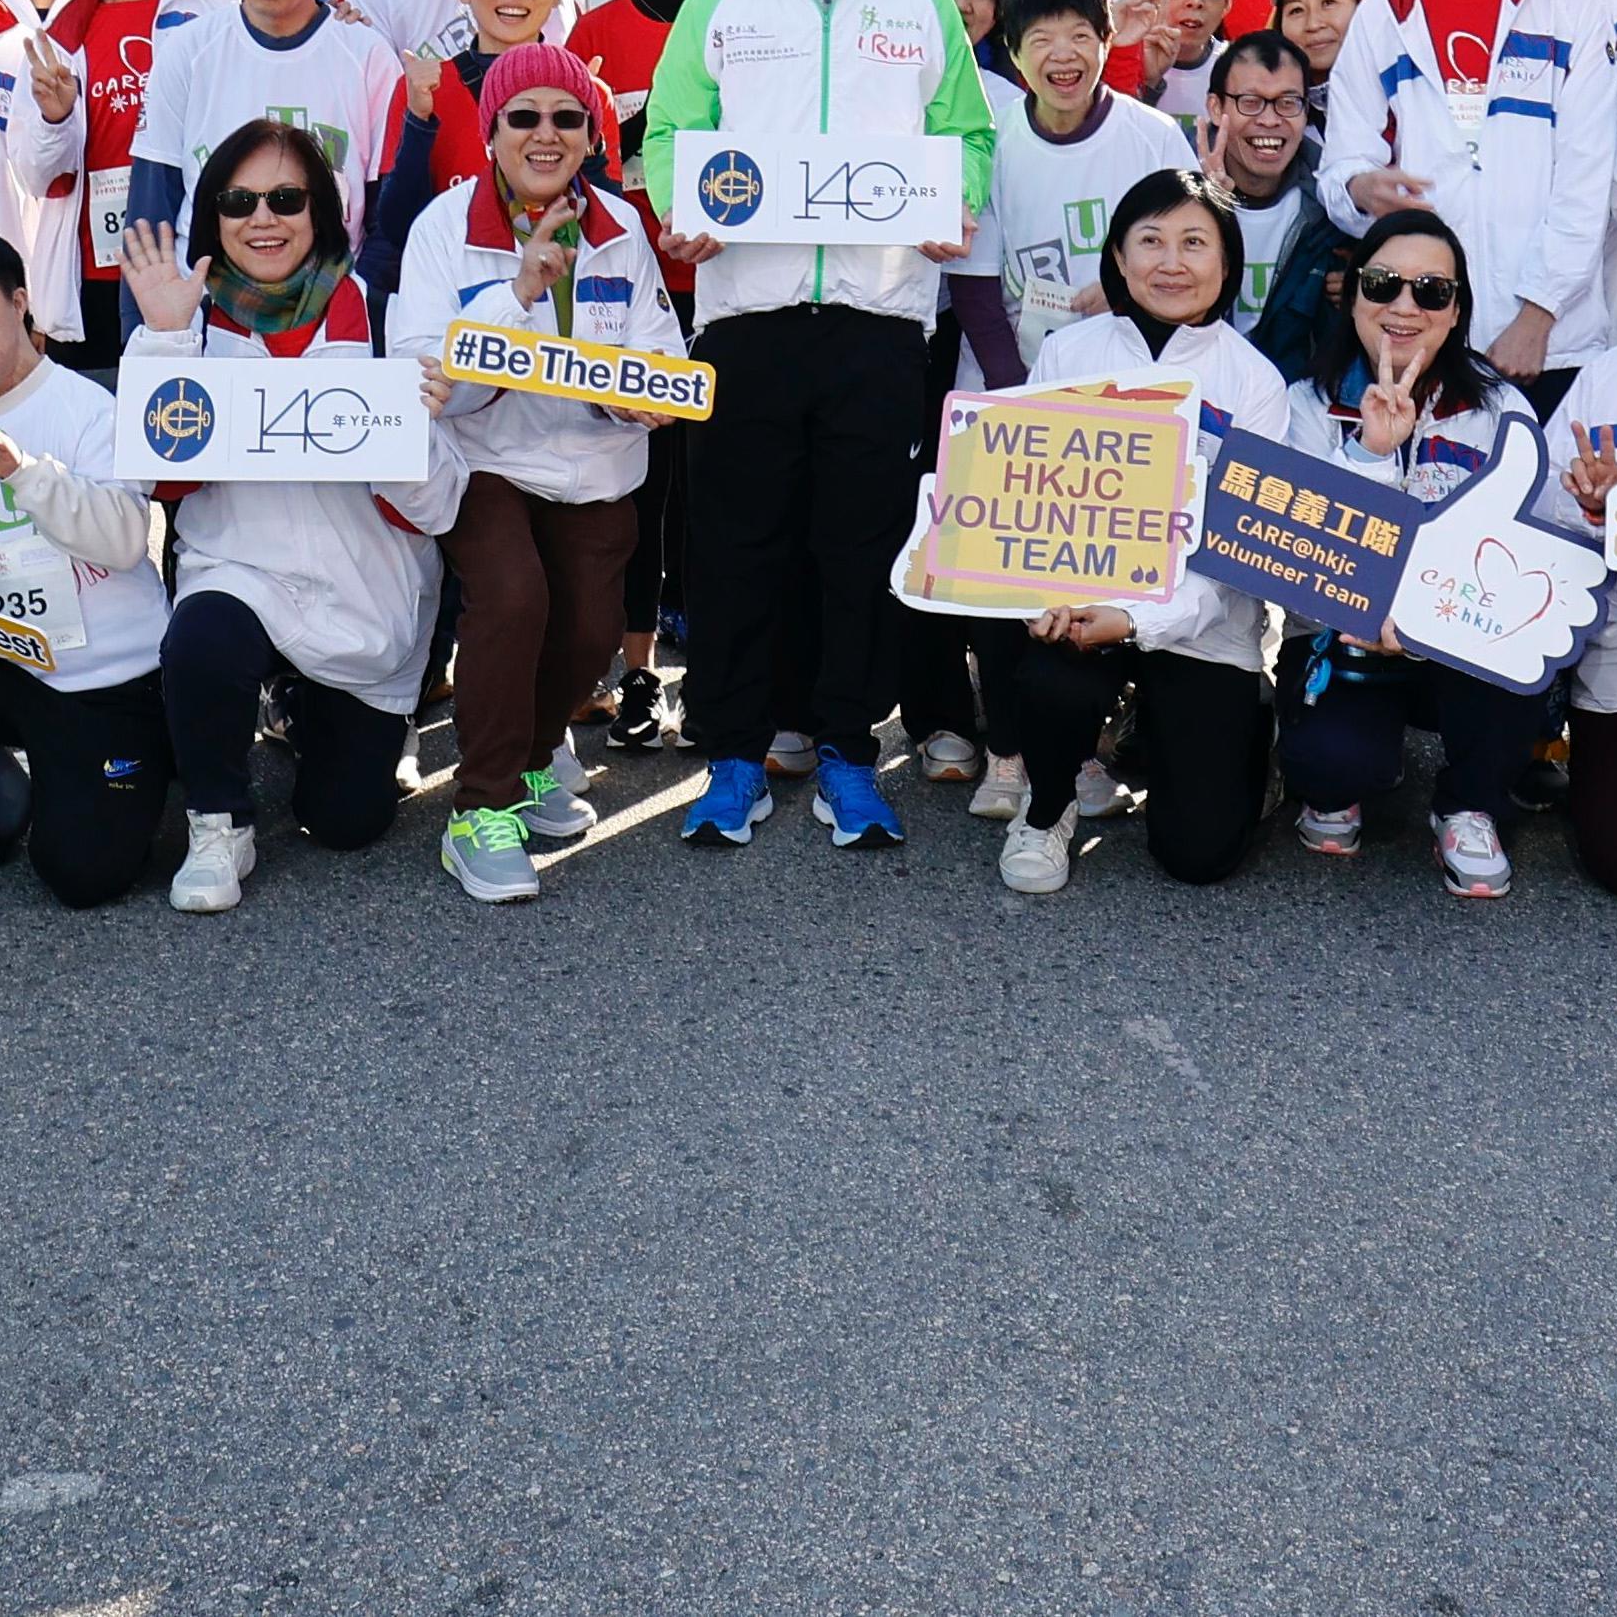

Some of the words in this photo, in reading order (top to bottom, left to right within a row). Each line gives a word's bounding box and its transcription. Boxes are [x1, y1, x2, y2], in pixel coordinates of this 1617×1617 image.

[872, 34, 925, 60] Run
[793, 161, 907, 222] 140
[873, 185, 886, 199] 年
[889, 186, 938, 198] YEARS
[454, 332, 531, 376] #Be
[540, 345, 611, 390] The
[619, 359, 706, 407] Best
[246, 388, 370, 455] 140
[332, 415, 346, 429] 年
[350, 414, 402, 427] YEARS
[983, 422, 1047, 455] WE
[1063, 427, 1152, 466] ARE
[1004, 461, 1125, 503] HKJC
[929, 493, 1195, 546] VOLUNTEER
[1219, 459, 1401, 559] 馬會義工隊
[1000, 537, 1117, 579] TEAM
[1236, 515, 1358, 576] CARE@hkjc
[1206, 530, 1308, 586] Volunteer
[1314, 570, 1371, 613] Team
[1420, 568, 1497, 609] CARE
